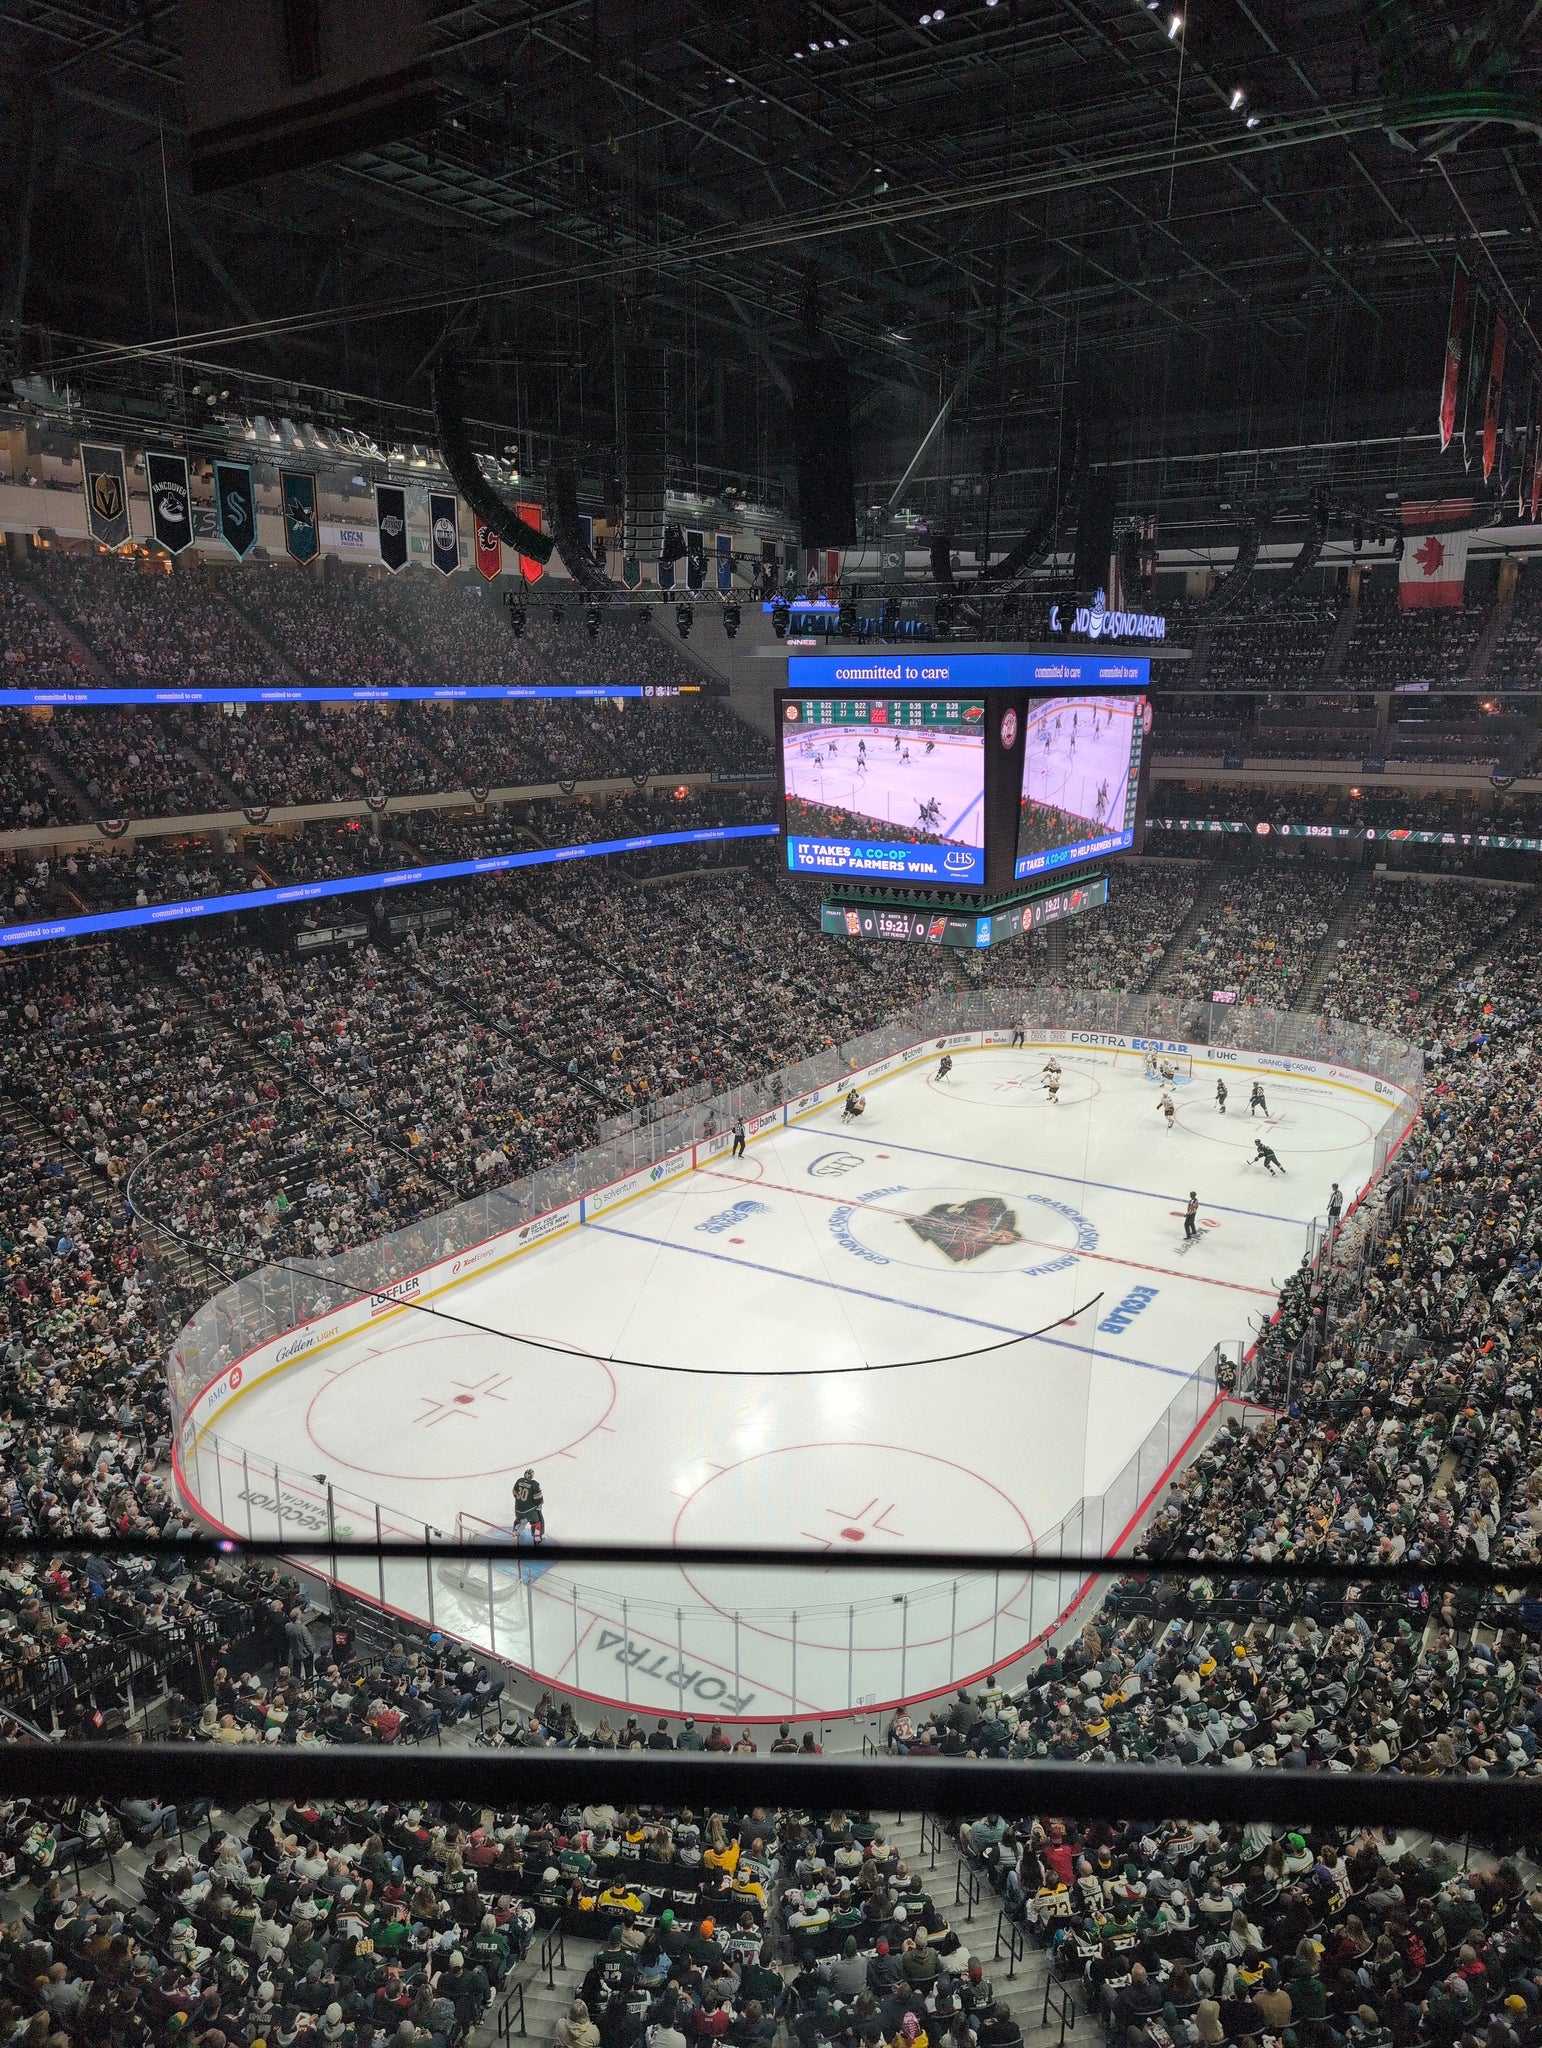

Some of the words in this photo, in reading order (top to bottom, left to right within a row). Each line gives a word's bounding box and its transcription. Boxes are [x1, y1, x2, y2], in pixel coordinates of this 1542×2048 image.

[152, 481, 187, 498] VANCOUVER
[340, 530, 363, 543] KFAN
[1051, 605, 1091, 632] GND
[1102, 611, 1138, 639] CASINO
[1136, 615, 1166, 639] ARENA
[836, 665, 901, 680] committed
[905, 666, 918, 679] to
[921, 668, 948, 680] care
[1035, 665, 1064, 678] committed
[1064, 666, 1069, 678] to
[1069, 667, 1081, 678] care
[1100, 665, 1123, 678] committed
[1124, 666, 1128, 677] to
[1128, 668, 1139, 677] care
[1282, 825, 1290, 835] 0
[1306, 826, 1332, 836] 19:21
[1366, 829, 1375, 839] 0
[798, 844, 809, 853] IT
[812, 845, 851, 857] TAKES
[854, 849, 863, 858] A
[947, 851, 972, 864] CHS
[1019, 862, 1026, 873] IT
[1026, 857, 1045, 871] TAKES
[1046, 856, 1050, 866] A
[1070, 848, 1078, 859] TO
[1078, 845, 1090, 857] HELP
[1090, 840, 1112, 854] FARMERS
[799, 855, 814, 864] TO
[817, 856, 847, 868] HELP
[849, 858, 905, 871] FARMERS
[908, 862, 938, 874] WIN.
[277, 888, 304, 899] committed
[152, 907, 184, 918] committed
[1045, 897, 1060, 913] 19:21
[1063, 898, 1068, 911] 0
[1036, 907, 1040, 921] 0
[864, 918, 872, 931] 0
[879, 920, 909, 933] 19:21
[916, 924, 924, 936] 0
[3, 928, 41, 941] committed
[51, 925, 66, 933] care
[1071, 1032, 1126, 1048] FORTRA
[907, 1046, 924, 1058] clover
[1216, 1052, 1238, 1061] UHC
[868, 1062, 891, 1077] FORTINET
[1258, 1058, 1283, 1067] GRAND
[1291, 1062, 1316, 1073] CASINO
[750, 1122, 758, 1132] us
[760, 1112, 777, 1127] bank
[666, 1160, 685, 1175] Hospital
[816, 1156, 865, 1178] CHS
[603, 1179, 637, 1202] solventum
[856, 1184, 910, 1204] ARENA
[530, 1222, 541, 1231] GET
[542, 1214, 558, 1225] YOUR
[531, 1222, 554, 1236] TICKETS
[554, 1214, 570, 1226] NOW!
[694, 1208, 737, 1232] CASINO
[708, 1212, 749, 1234] GRAND
[828, 1205, 852, 1233] CASINO
[1026, 1194, 1080, 1218] GRAND
[1078, 1221, 1100, 1251] CASINO
[463, 1256, 478, 1268] Xcel
[477, 1247, 496, 1262] Energy
[839, 1239, 890, 1266] GRAND
[1021, 1254, 1081, 1277] ARENA
[371, 1277, 420, 1308] LOFFLER
[1096, 1284, 1160, 1335] ECOLAB
[276, 1337, 314, 1363] Golden
[316, 1326, 340, 1343] LIGHT
[1222, 1370, 1234, 1382] 25
[208, 1382, 228, 1408] BMO
[516, 1486, 529, 1502] 30
[280, 1492, 339, 1520] NANCIAL
[596, 1628, 756, 1715] FORTRA
[476, 1942, 498, 1951] WILD
[733, 1939, 756, 1950] KAPRIZOV
